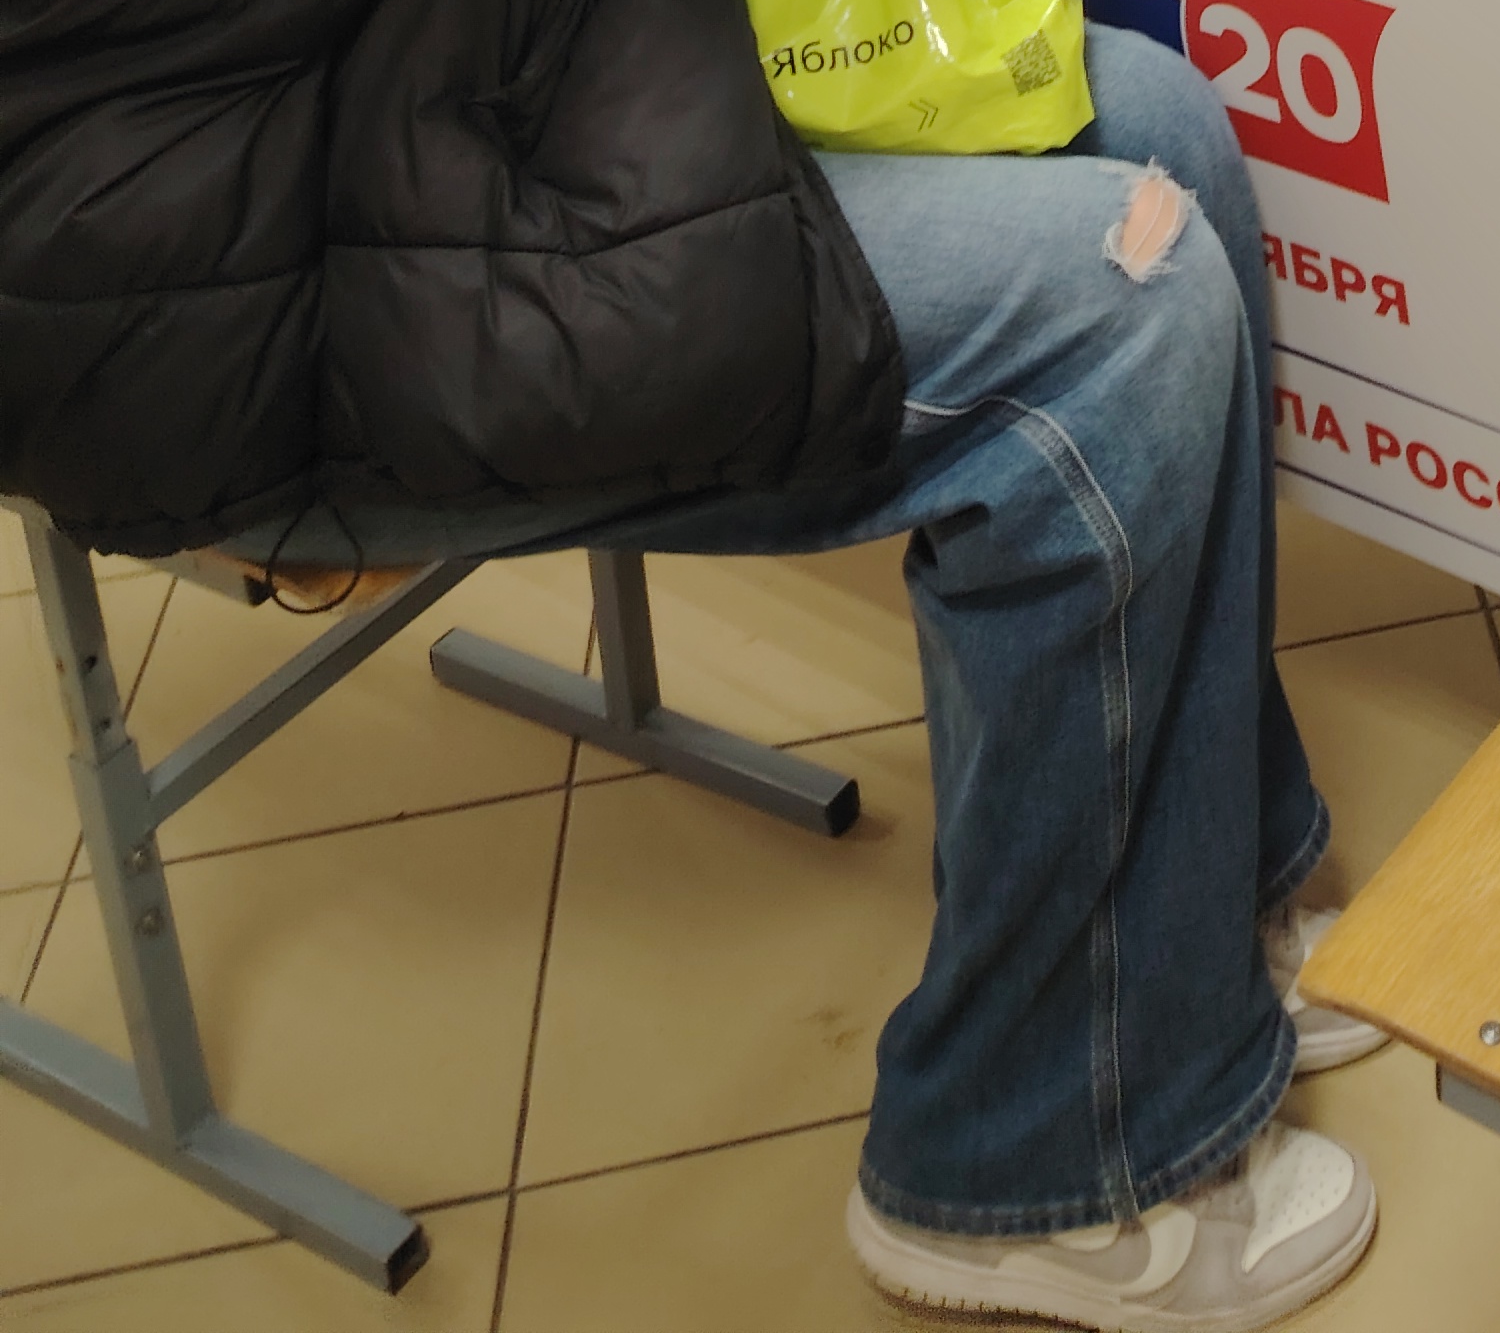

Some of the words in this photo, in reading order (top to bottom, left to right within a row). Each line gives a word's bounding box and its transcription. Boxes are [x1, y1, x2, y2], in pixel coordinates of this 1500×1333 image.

[772, 19, 915, 79] Яблоко
[1199, 3, 1364, 145] 20
[1263, 232, 1411, 326] ЯБРЯ
